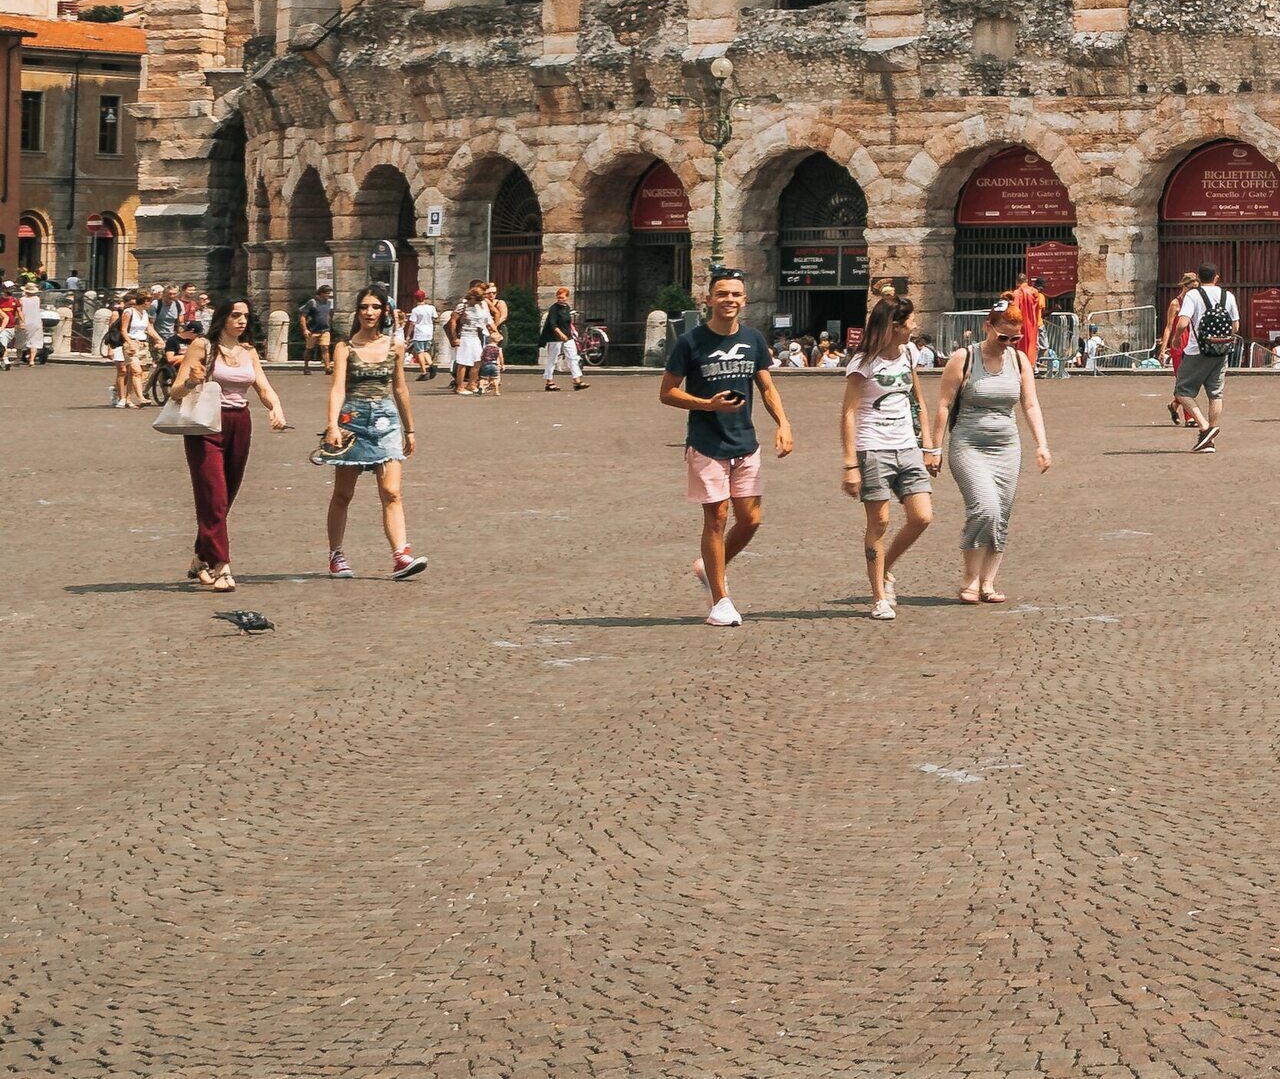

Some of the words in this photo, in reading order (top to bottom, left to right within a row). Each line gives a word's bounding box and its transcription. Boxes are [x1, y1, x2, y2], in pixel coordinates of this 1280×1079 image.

[1204, 170, 1276, 180] BIGLIETTERIA
[976, 177, 1038, 187] GRADINATA
[1201, 180, 1239, 189] TICKET
[1240, 180, 1279, 189] OFFICE
[1001, 190, 1029, 198] Entrata
[1036, 190, 1055, 198] Gate
[1205, 190, 1240, 198] Cancello
[1248, 190, 1267, 198] Gate
[1268, 190, 1275, 198] 7
